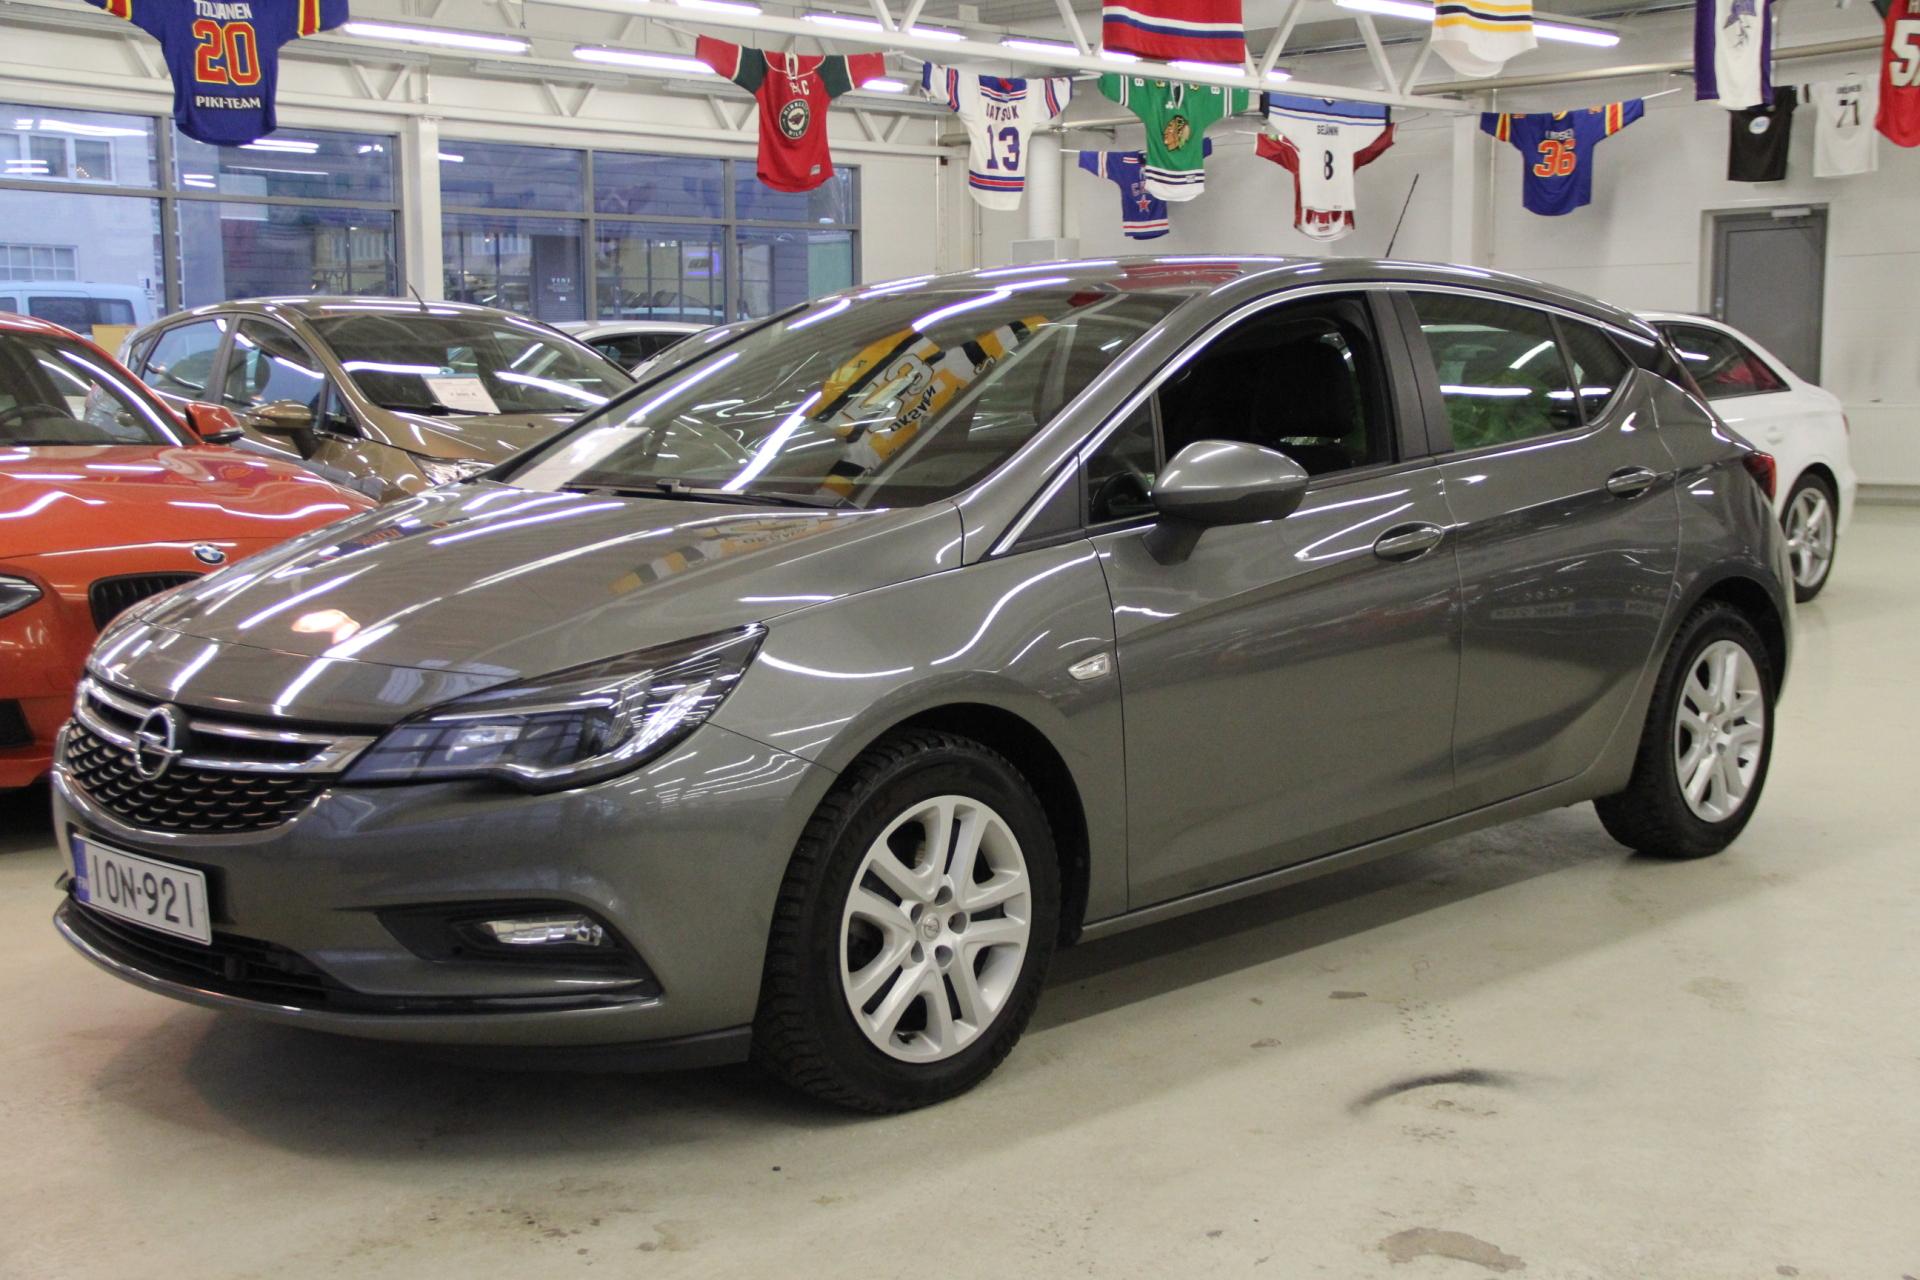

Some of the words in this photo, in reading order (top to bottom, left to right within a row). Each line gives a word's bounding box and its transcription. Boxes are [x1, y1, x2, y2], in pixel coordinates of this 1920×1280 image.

[192, 19, 261, 86] 20
[1889, 20, 1920, 87] 5
[195, 95, 261, 109] PIKI-TEAM
[986, 124, 1020, 171] 13
[1324, 149, 1334, 180] 8
[1533, 138, 1577, 177] 36
[94, 855, 194, 928] ION-921
